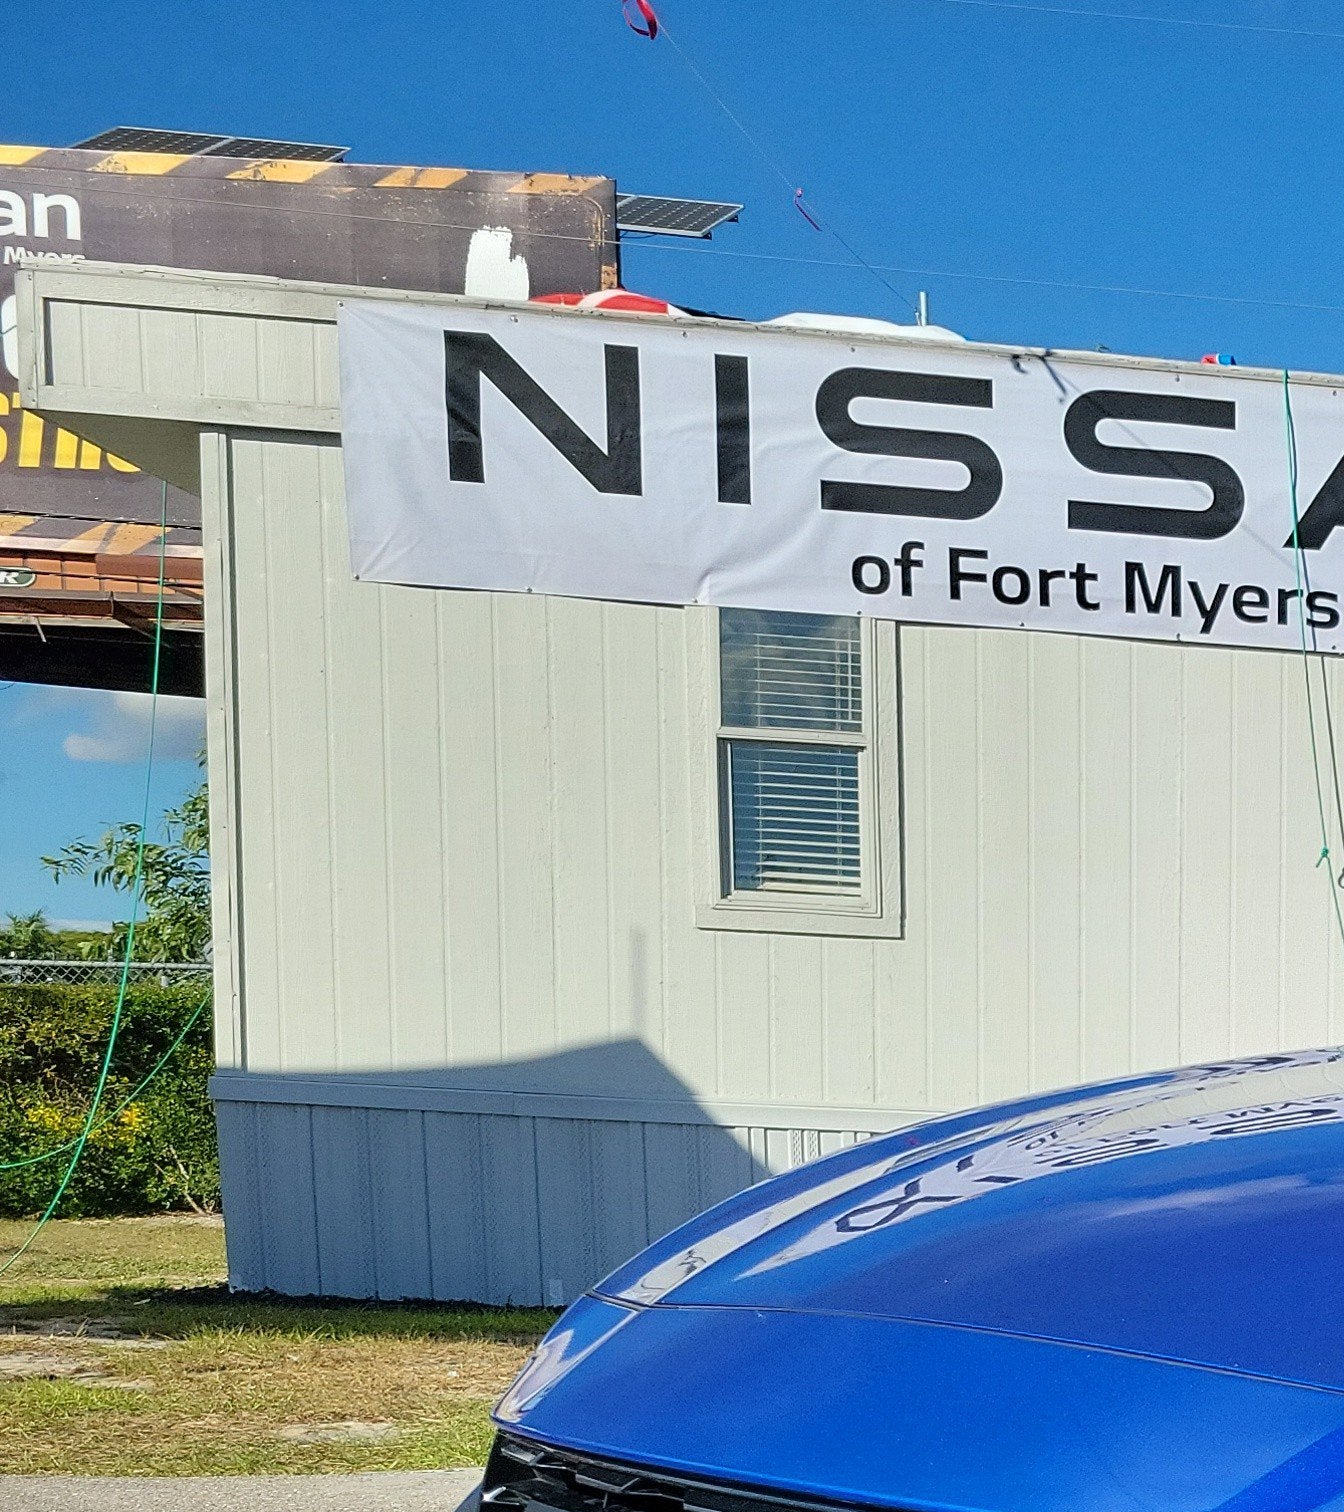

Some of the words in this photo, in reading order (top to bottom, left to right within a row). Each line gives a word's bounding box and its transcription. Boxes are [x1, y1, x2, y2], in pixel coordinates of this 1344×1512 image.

[851, 540, 925, 597] of
[948, 546, 1101, 611] Fort
[1124, 560, 1341, 635] Myers
